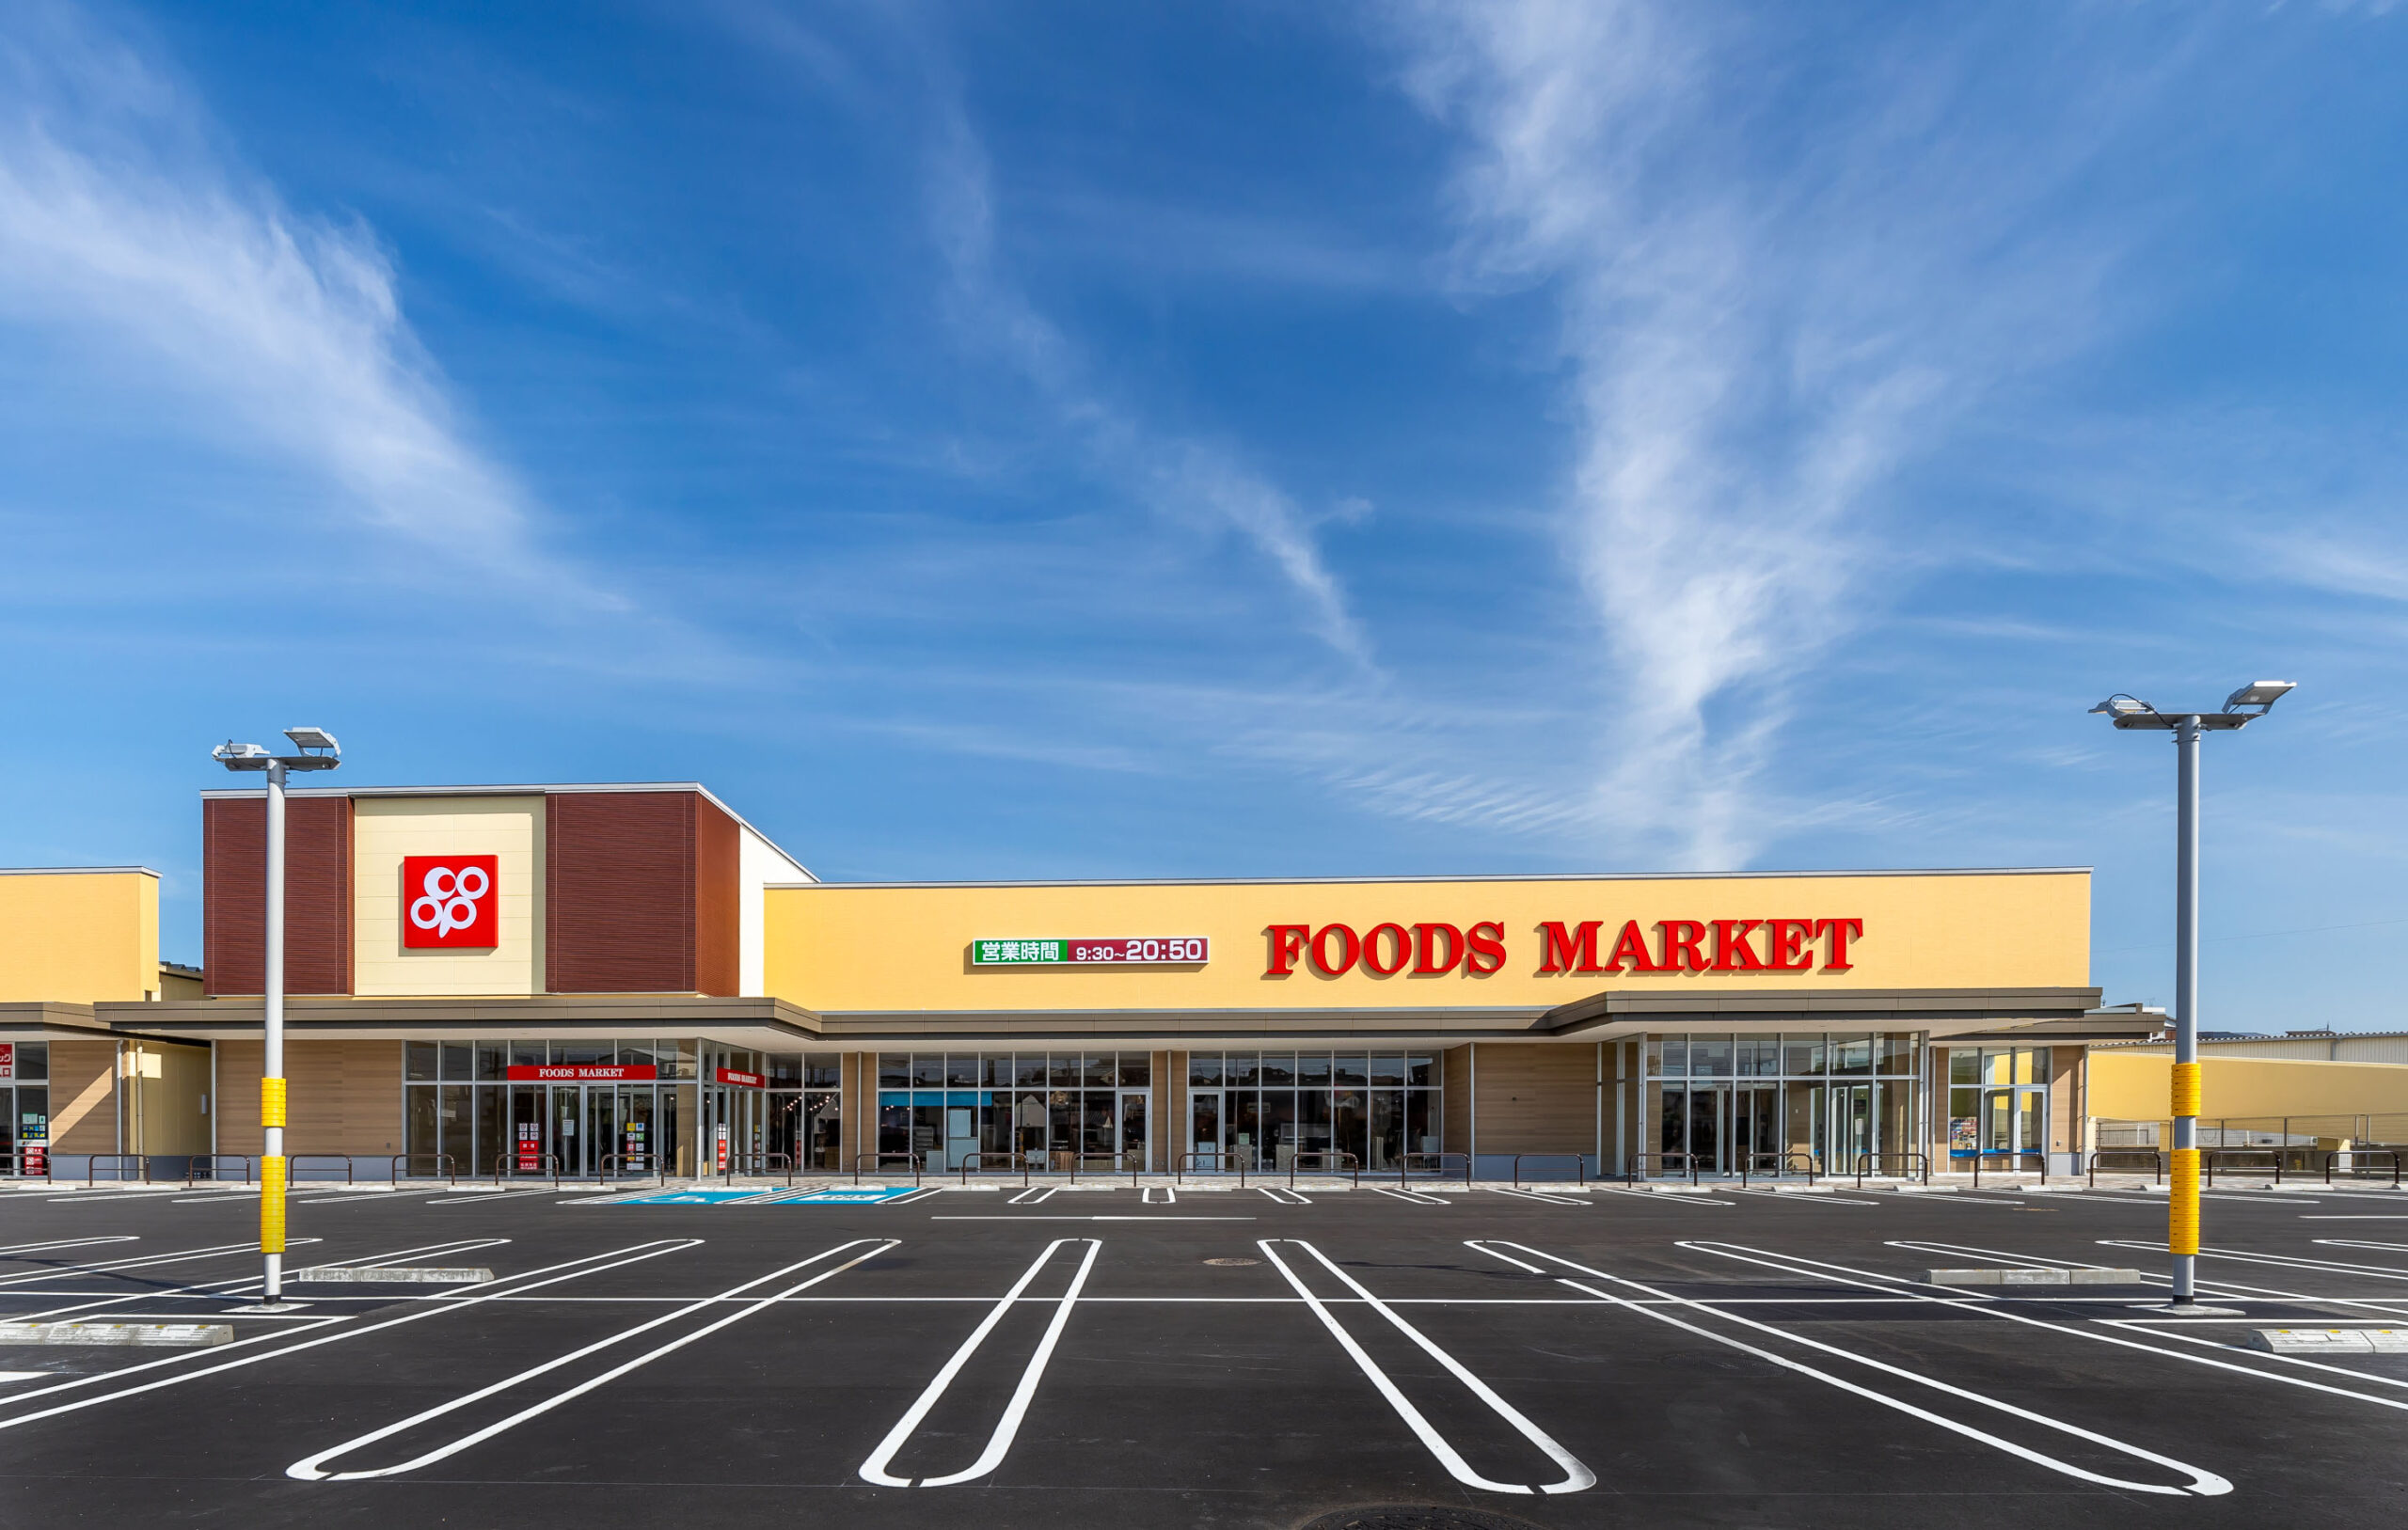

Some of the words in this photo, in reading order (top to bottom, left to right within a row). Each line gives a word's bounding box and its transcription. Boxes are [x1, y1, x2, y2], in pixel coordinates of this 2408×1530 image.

[981, 941, 1059, 961] 営業時間
[1266, 922, 1507, 975] FOODS
[1540, 918, 1863, 972] MARKET
[539, 1068, 575, 1078] FOODS
[578, 1068, 625, 1078] MARKET
